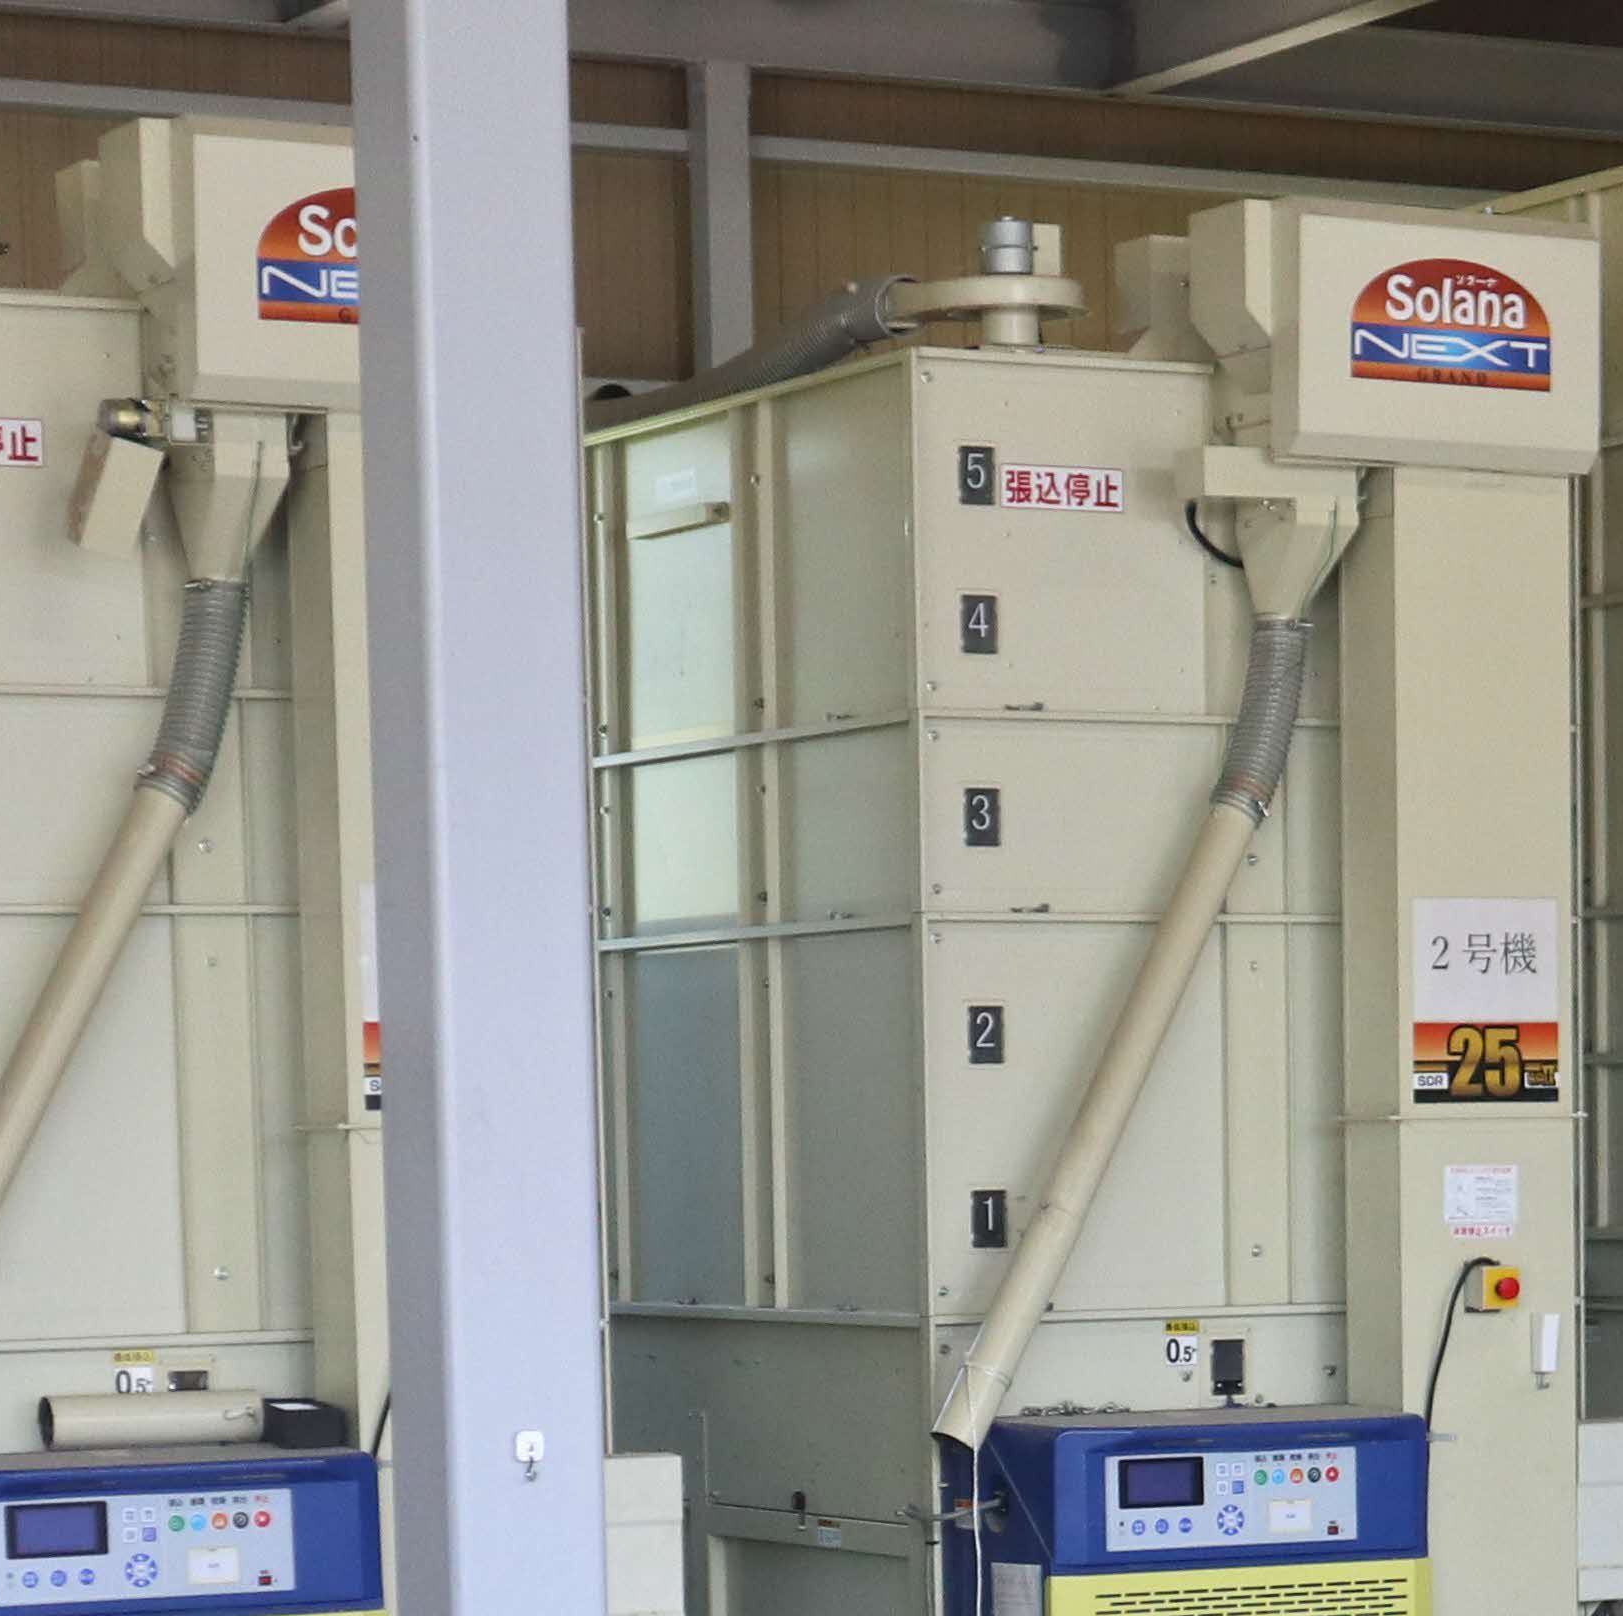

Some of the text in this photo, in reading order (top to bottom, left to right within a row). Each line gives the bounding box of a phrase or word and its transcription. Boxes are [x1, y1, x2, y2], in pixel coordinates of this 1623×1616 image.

[1384, 273, 1526, 330] Solana
[1353, 328, 1548, 369] NEXT
[1416, 367, 1488, 385] GRAND
[967, 453, 985, 489] 5
[1005, 469, 1119, 508] 張込停止
[968, 602, 989, 638] 4
[971, 794, 991, 830] 3
[1431, 932, 1538, 975] 2号機
[975, 1011, 995, 1048] 2
[1447, 1024, 1522, 1097] 25
[982, 1196, 994, 1230] 1
